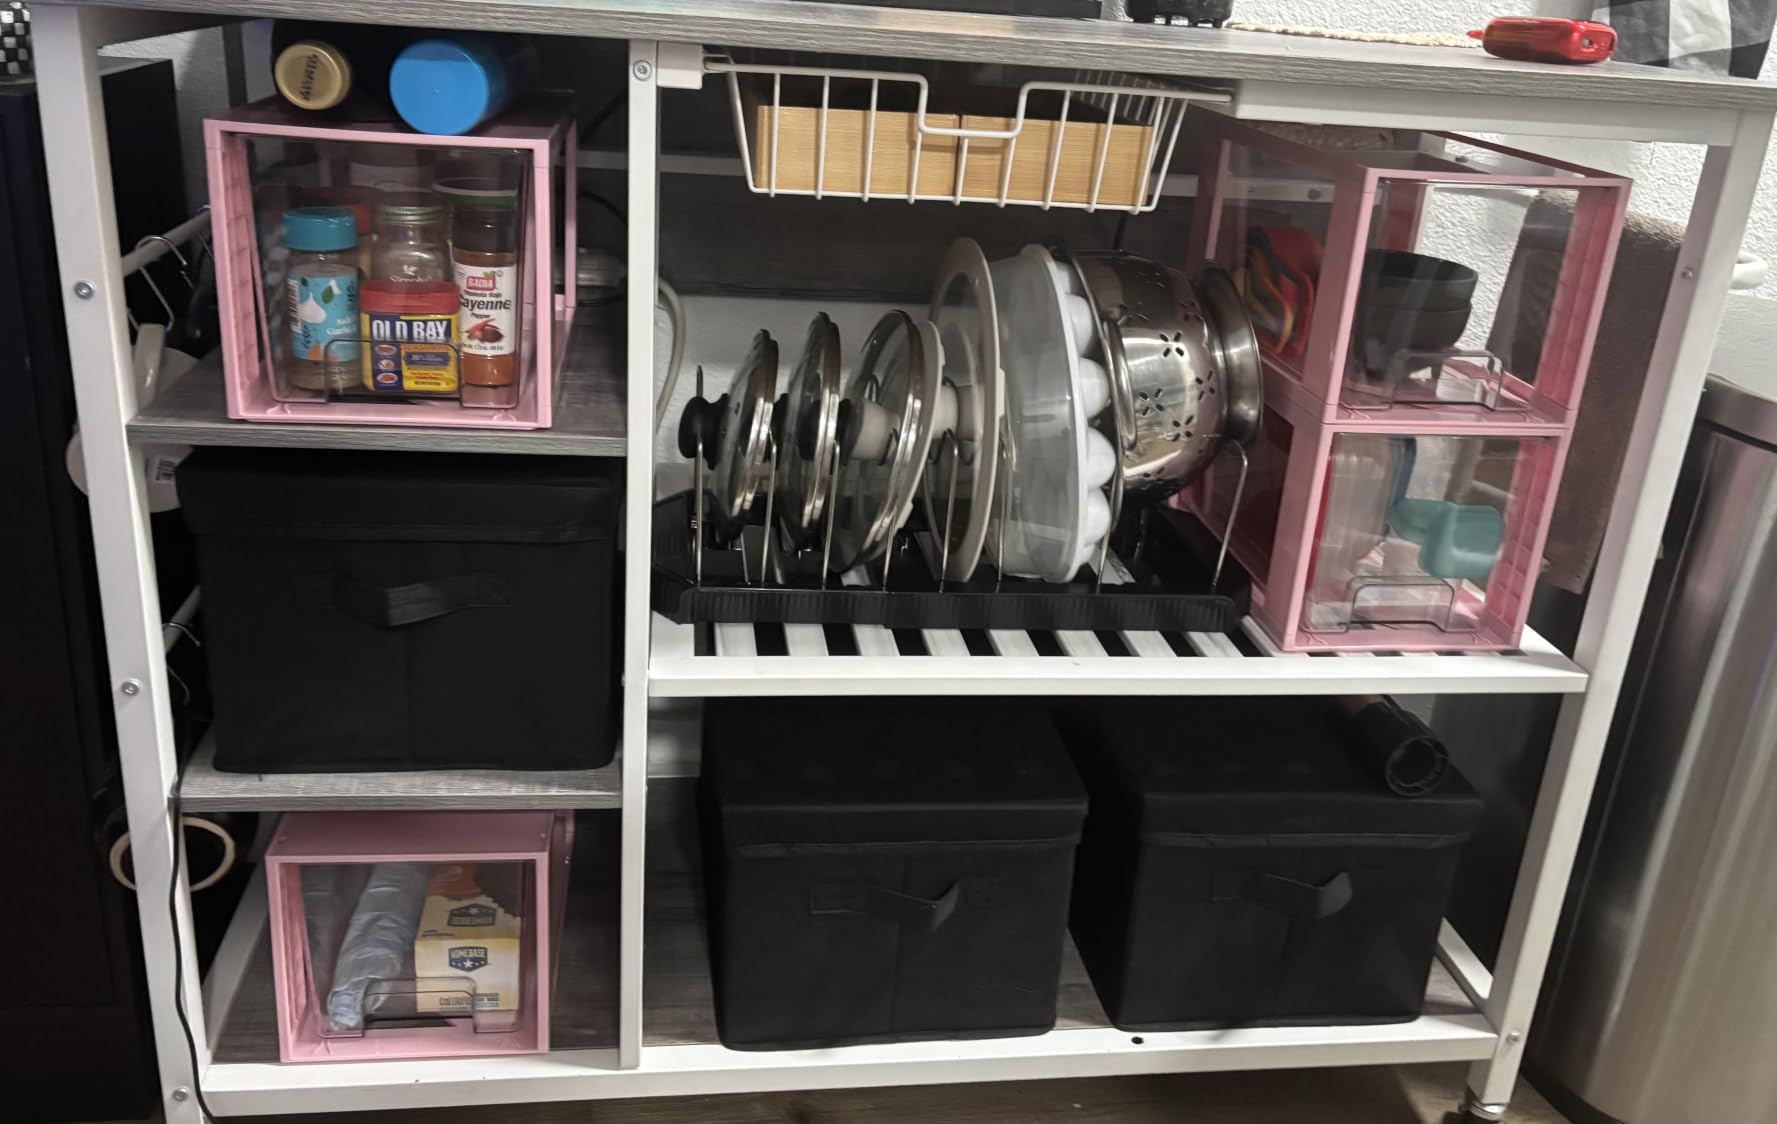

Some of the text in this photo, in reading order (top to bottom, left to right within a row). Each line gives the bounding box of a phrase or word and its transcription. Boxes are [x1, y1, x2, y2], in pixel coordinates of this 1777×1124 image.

[467, 277, 493, 288] BADIA
[371, 319, 448, 343] OLD BAY
[450, 948, 486, 959] HOMEBASE
